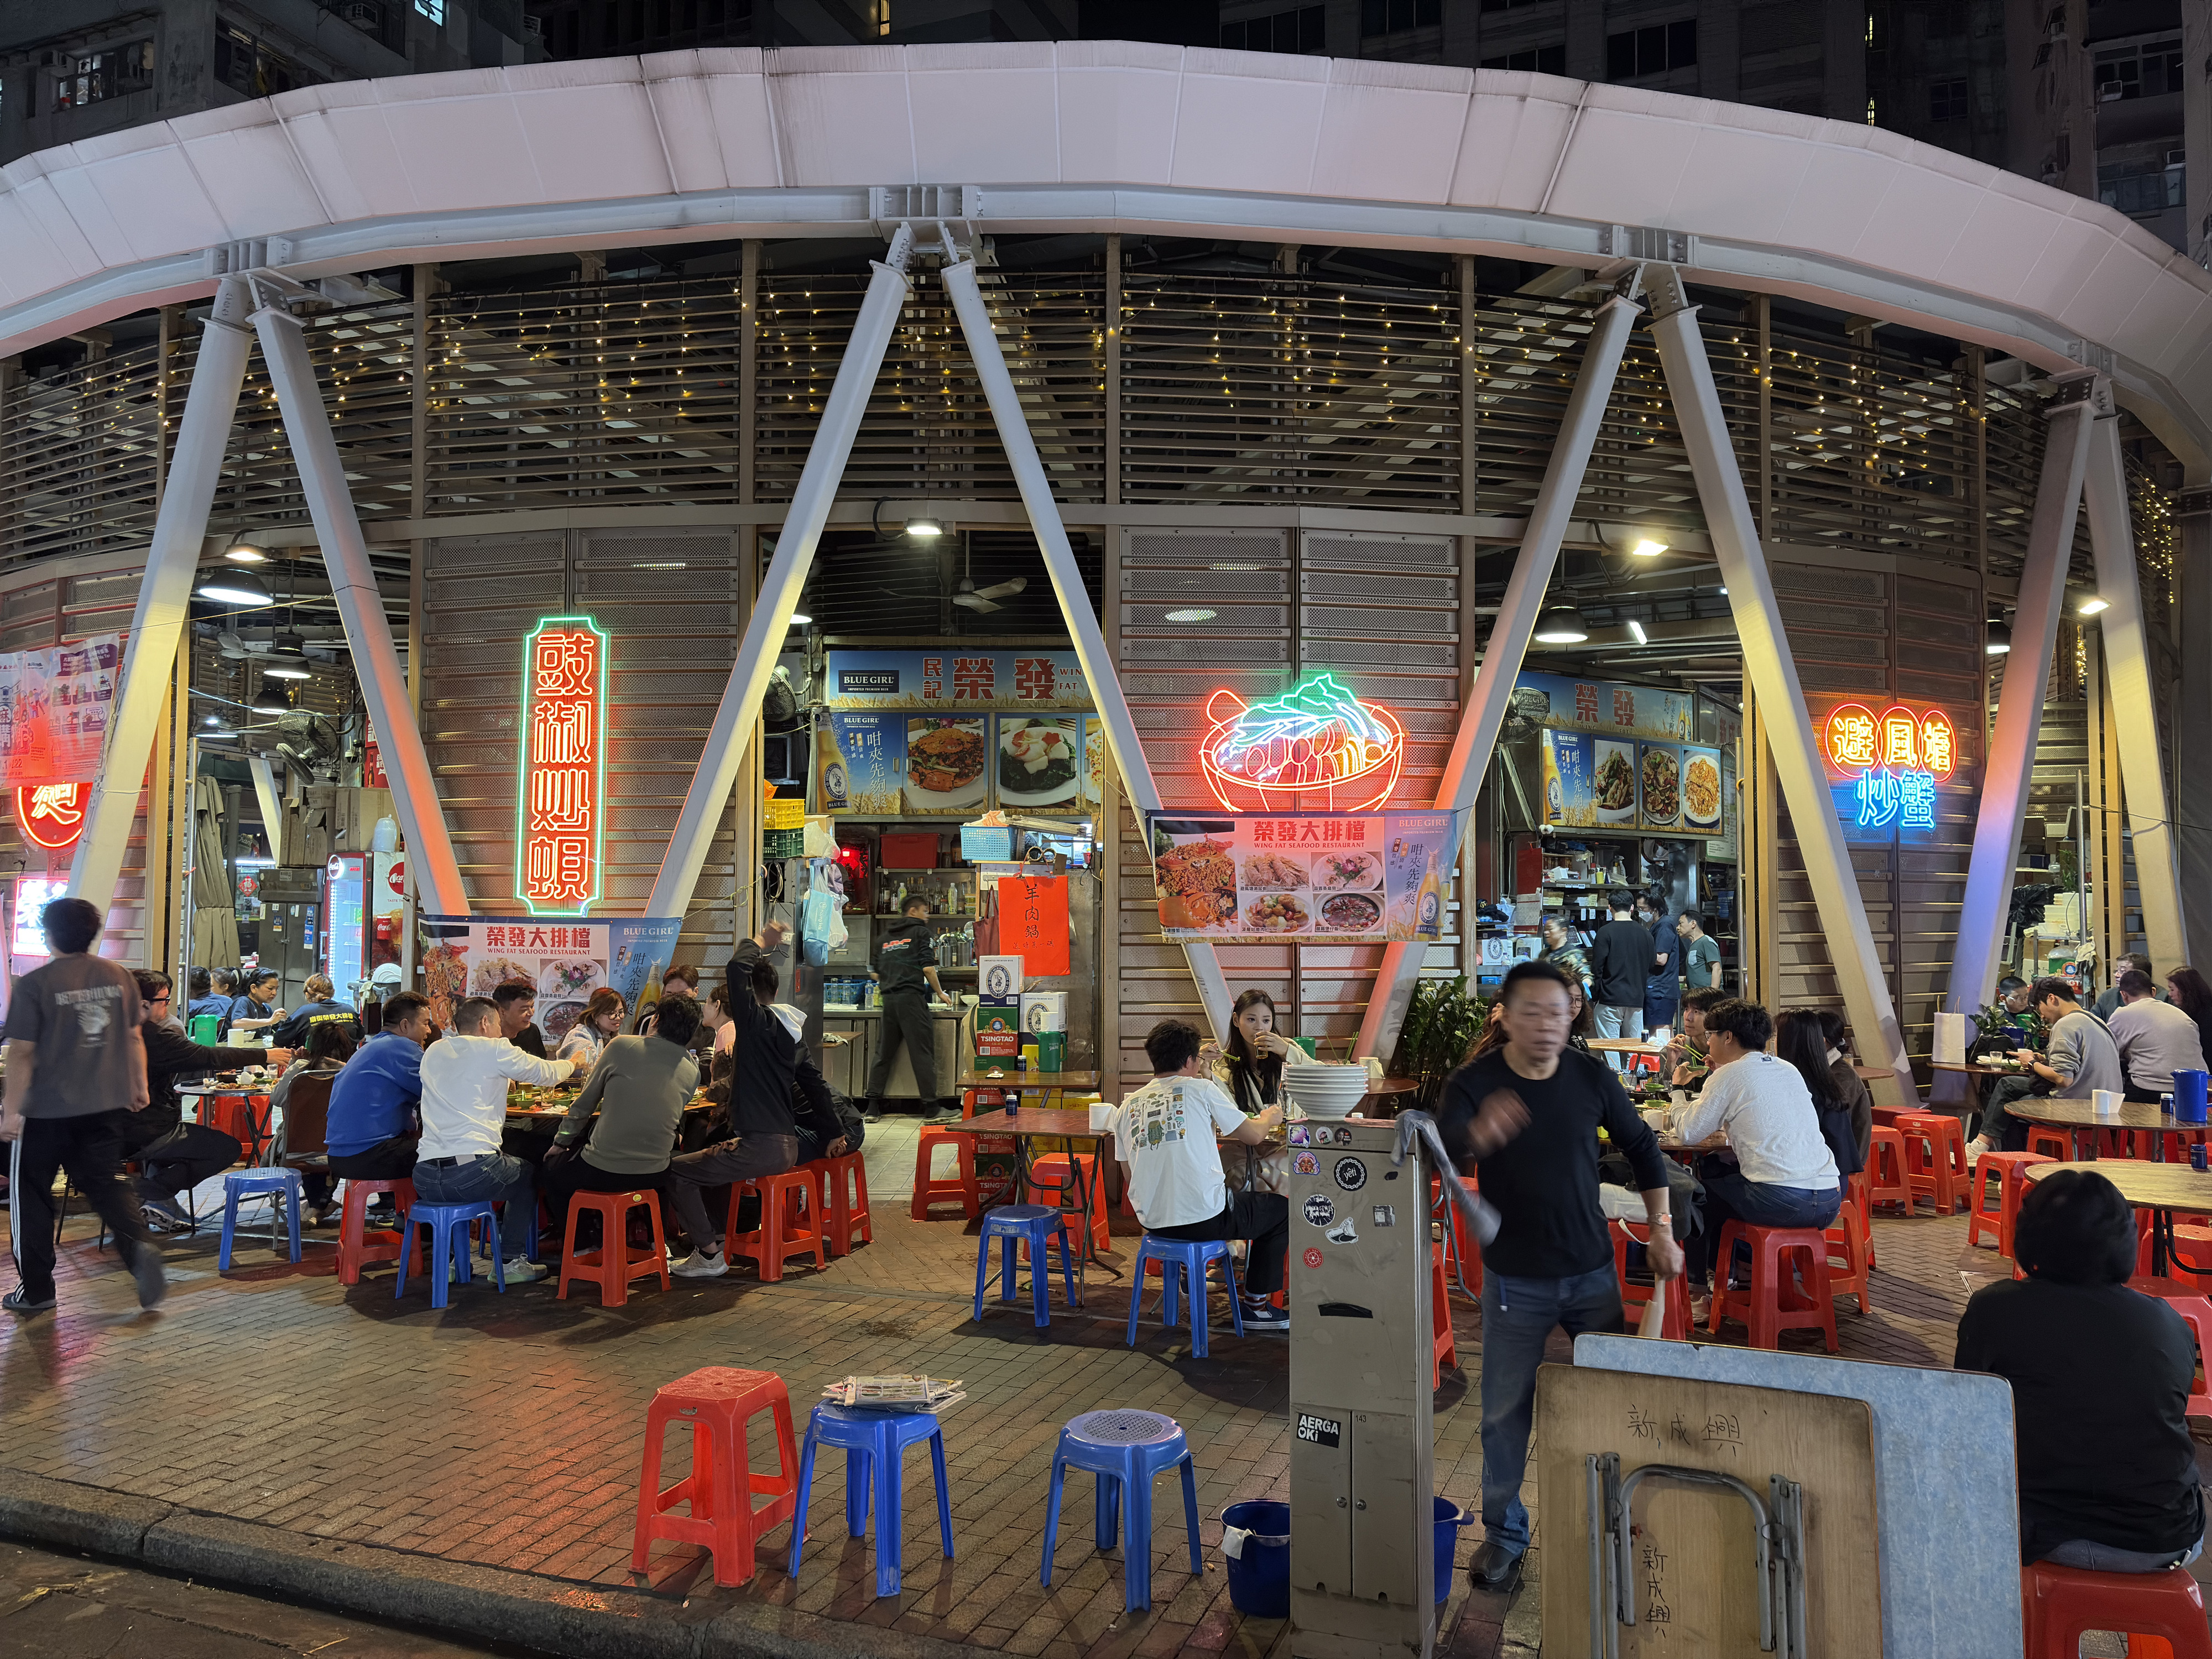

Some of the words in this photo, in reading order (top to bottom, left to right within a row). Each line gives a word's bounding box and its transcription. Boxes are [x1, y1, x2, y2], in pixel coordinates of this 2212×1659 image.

[923, 658, 942, 700] 民記
[953, 658, 1056, 700] 榮發
[1575, 684, 1635, 727] 榮發
[1834, 716, 1950, 771] 避風塘
[528, 633, 594, 900] 豉椒炒蜆
[867, 731, 888, 811] 咁夾先夠爽
[1858, 768, 1935, 828] 炒蟹
[1254, 821, 1365, 841] 榮發大排檔
[1403, 844, 1423, 905] 咁夾先夠爽
[1025, 884, 1040, 938] 羊肉鍋
[487, 926, 591, 948] 榮發大排檔
[1344, 1167, 1357, 1181] yêti
[1299, 1415, 1338, 1435] AERGA
